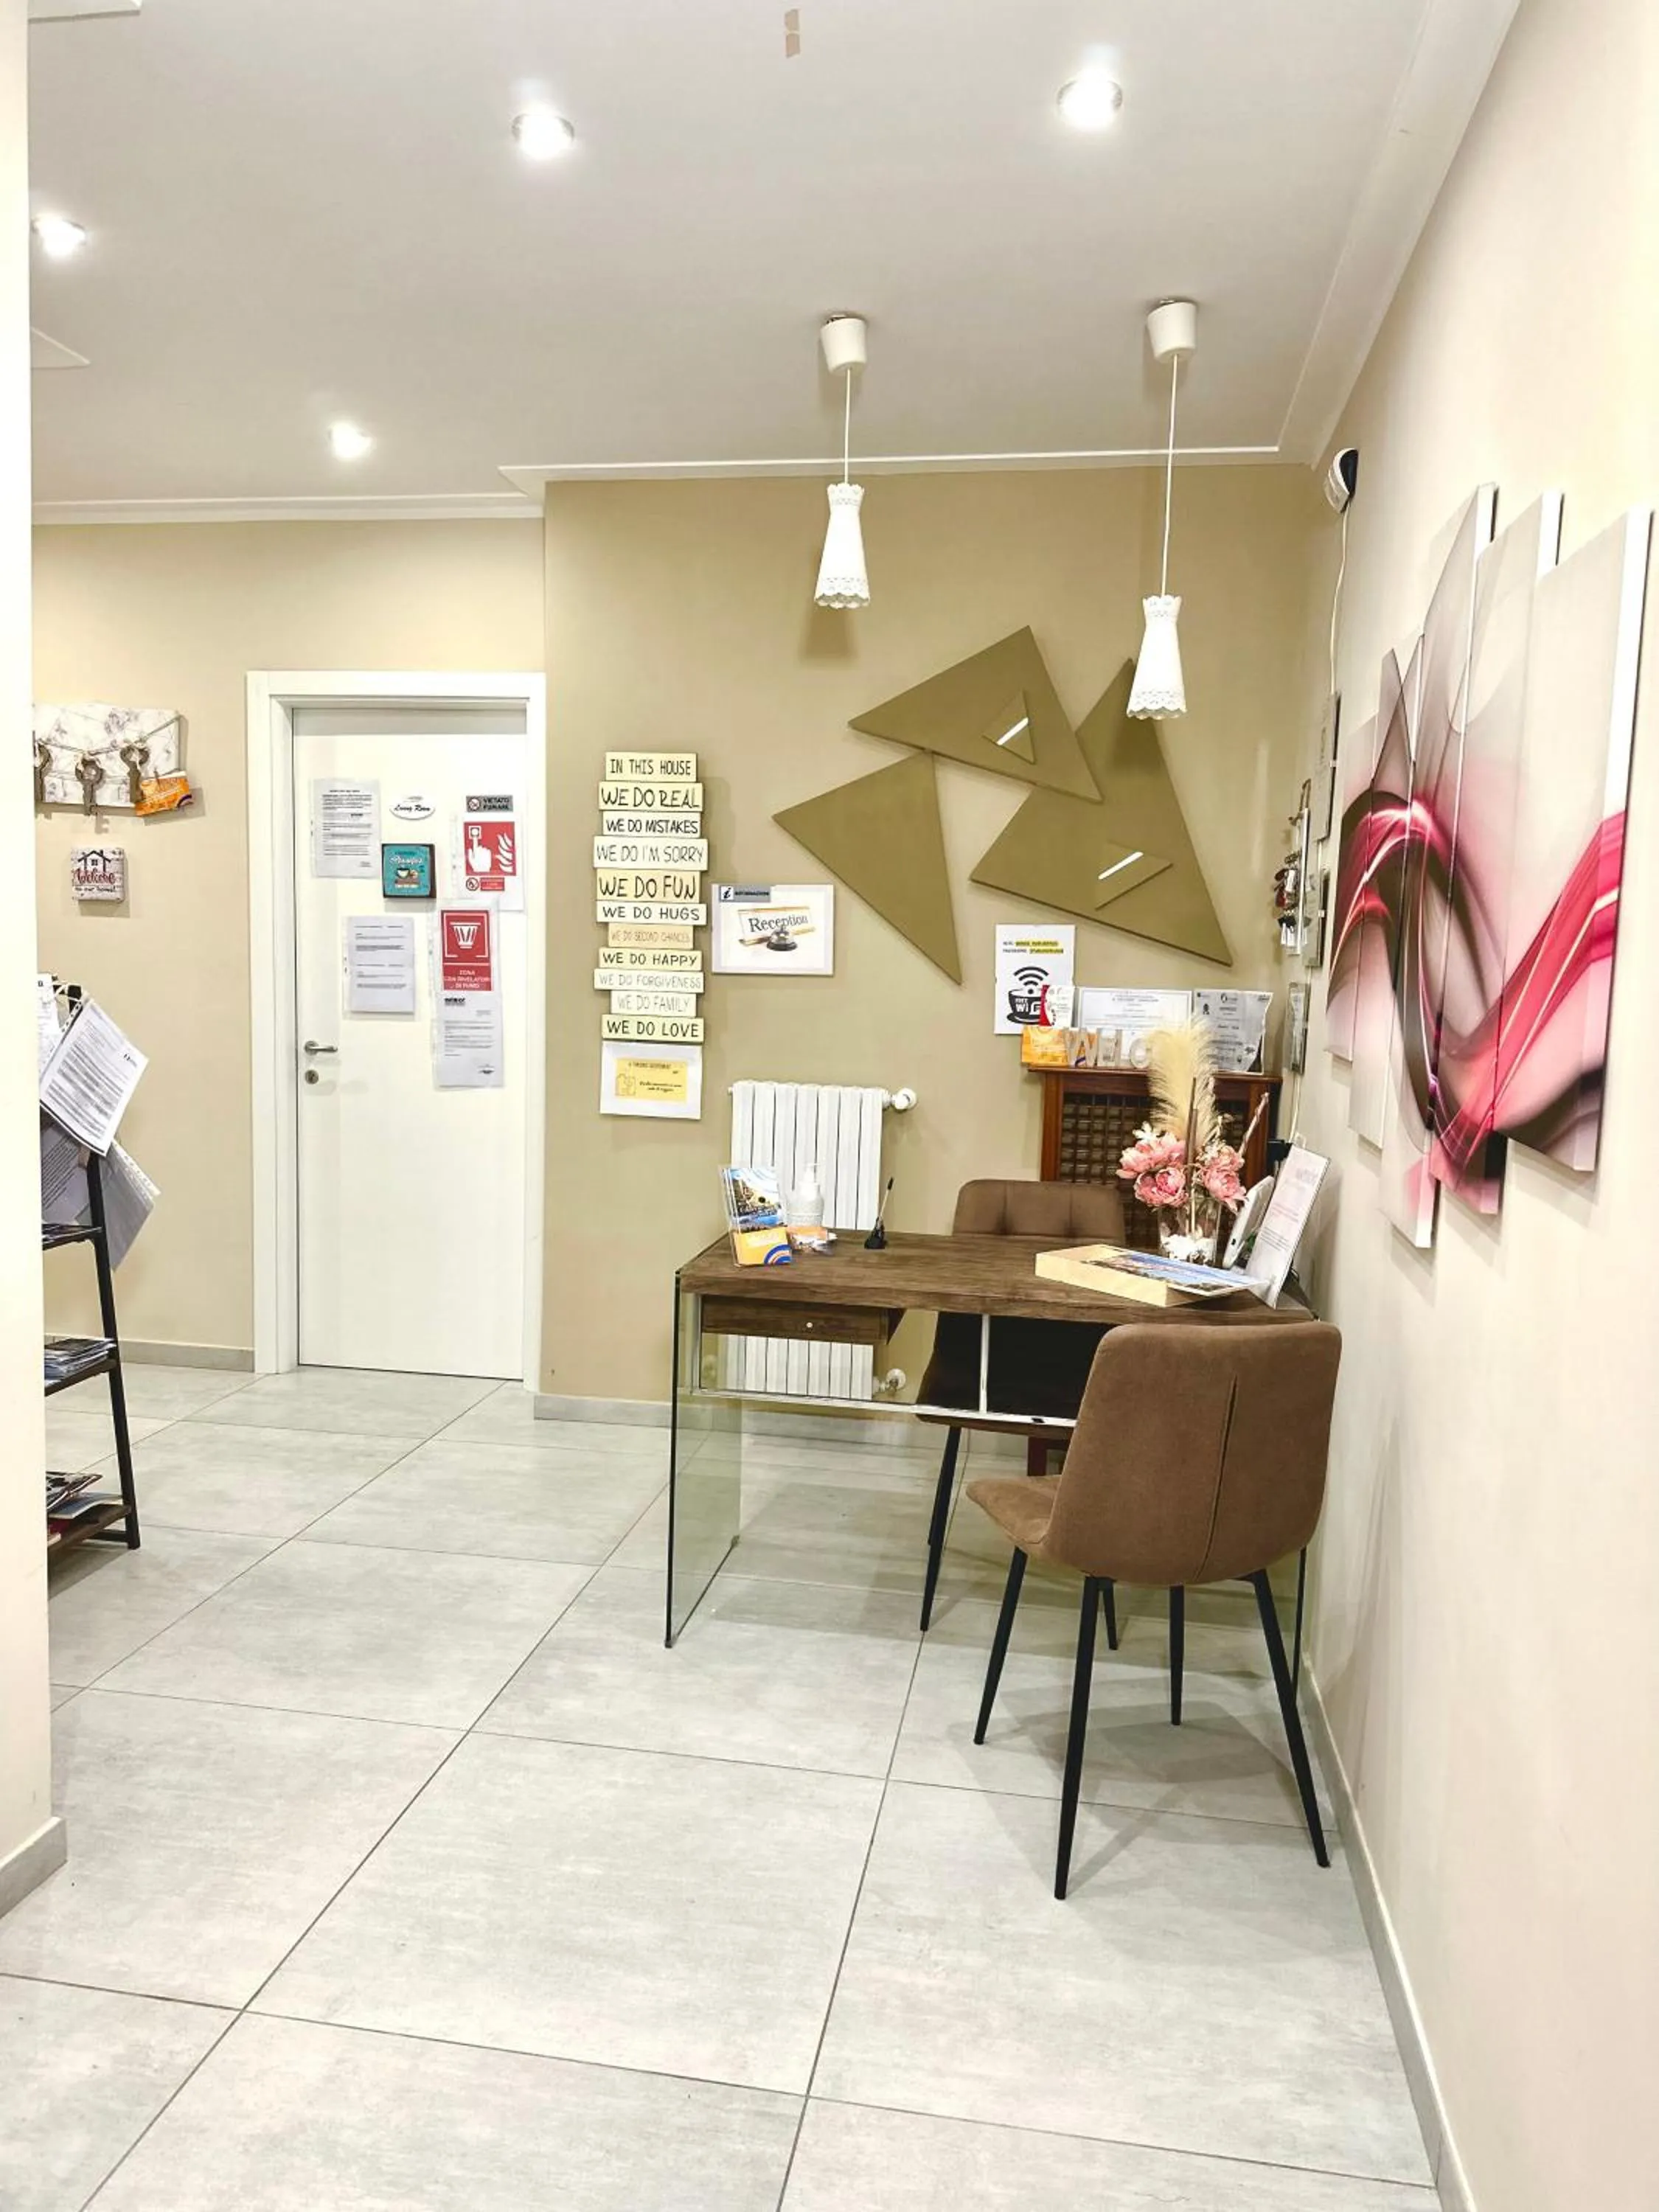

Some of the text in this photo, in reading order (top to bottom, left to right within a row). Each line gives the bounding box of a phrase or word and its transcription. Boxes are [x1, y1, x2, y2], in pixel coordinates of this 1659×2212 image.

[610, 759, 691, 776] IN THIS HOUSE
[601, 787, 699, 809] WE DO REAL
[606, 818, 698, 834] WE DO MISTAKES
[597, 844, 703, 863] WE DO I'M SORRY
[599, 875, 696, 900] WE DO FUN
[602, 905, 700, 922] WE DO HUGS
[747, 914, 809, 933] Reception
[602, 952, 698, 967] WE DO HAPPY
[598, 973, 701, 989] WE DO FORGIVENESS
[617, 995, 691, 1012] WE DO FAMILY
[607, 1020, 699, 1038] WE DO LOVE
